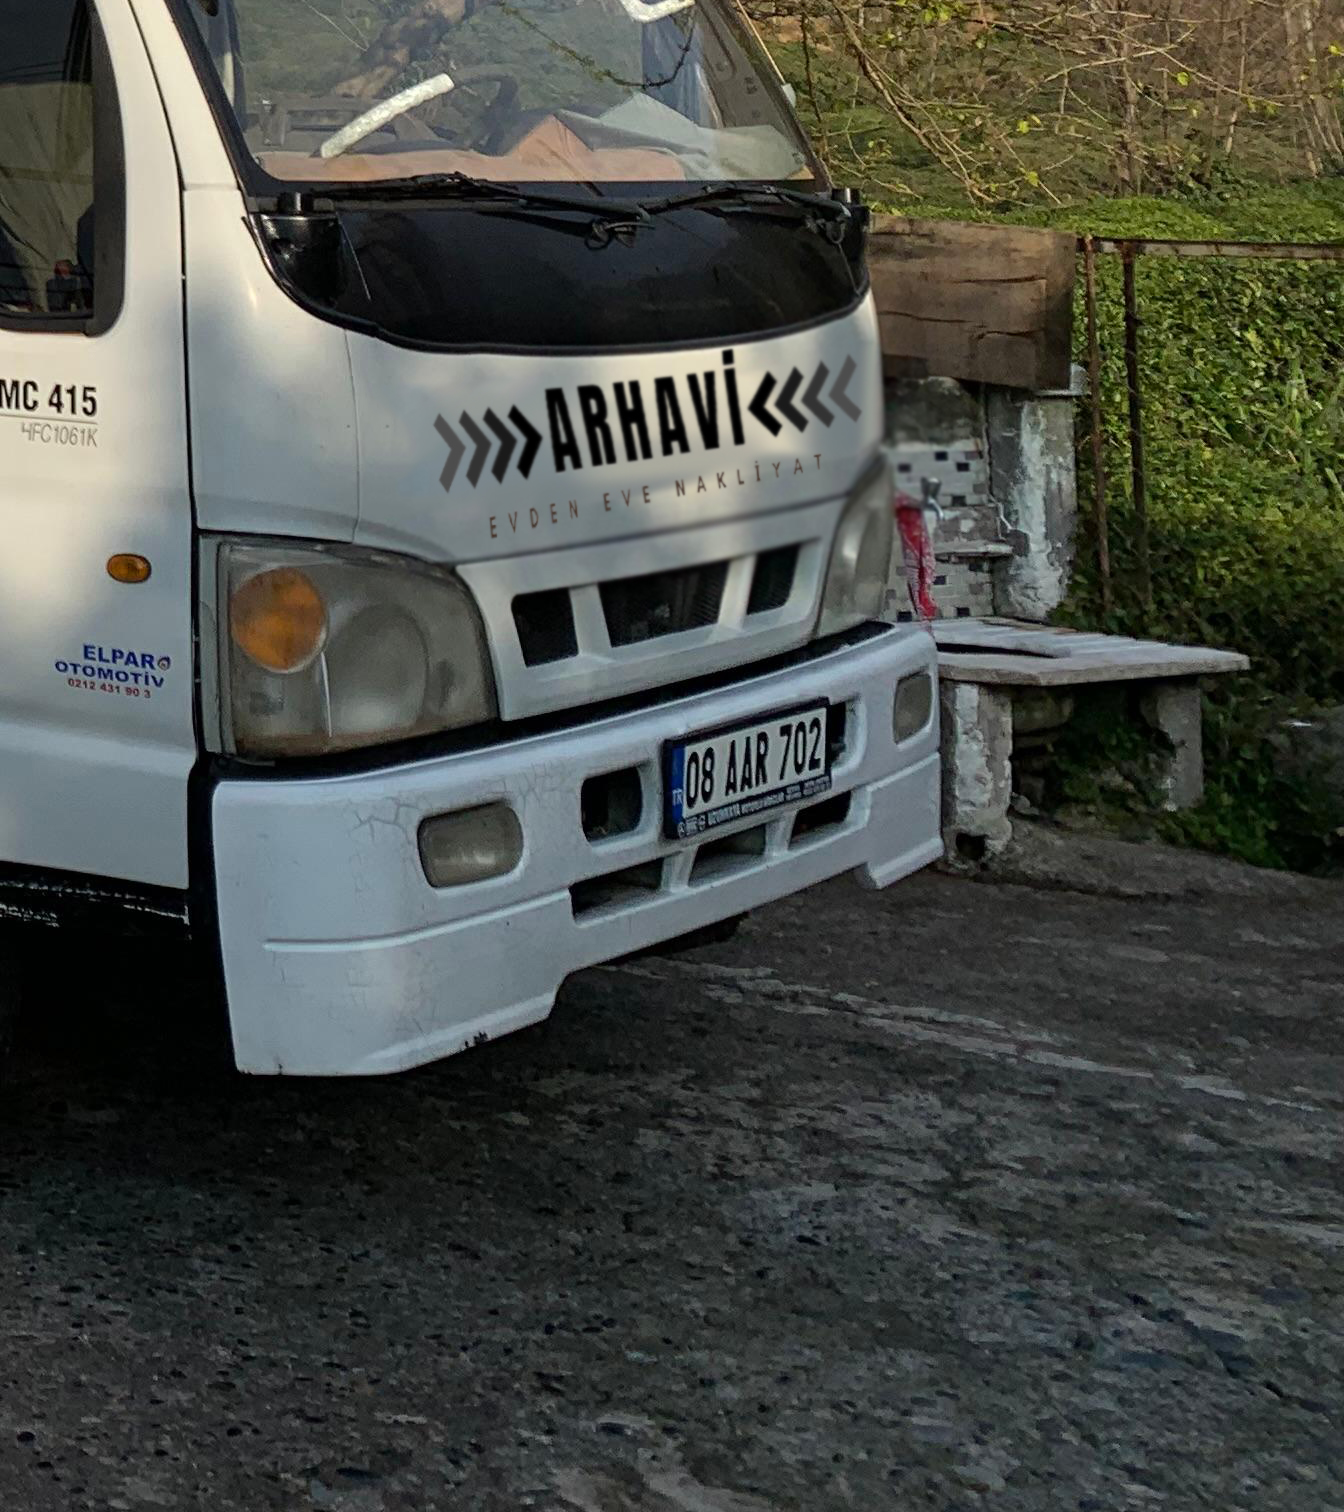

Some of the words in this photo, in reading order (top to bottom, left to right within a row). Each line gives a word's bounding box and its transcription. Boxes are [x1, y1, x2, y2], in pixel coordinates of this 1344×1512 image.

[48, 384, 98, 417] 415
[545, 349, 745, 473] ARHAVİ
[489, 500, 579, 538] EVDEN
[603, 486, 651, 512] EVE
[675, 454, 822, 498] NAKLİYAT
[55, 661, 164, 688] OTOMOTİV
[686, 747, 715, 809] 08
[725, 731, 769, 796] AAR
[779, 717, 822, 780] 702
[672, 788, 683, 806] TR
